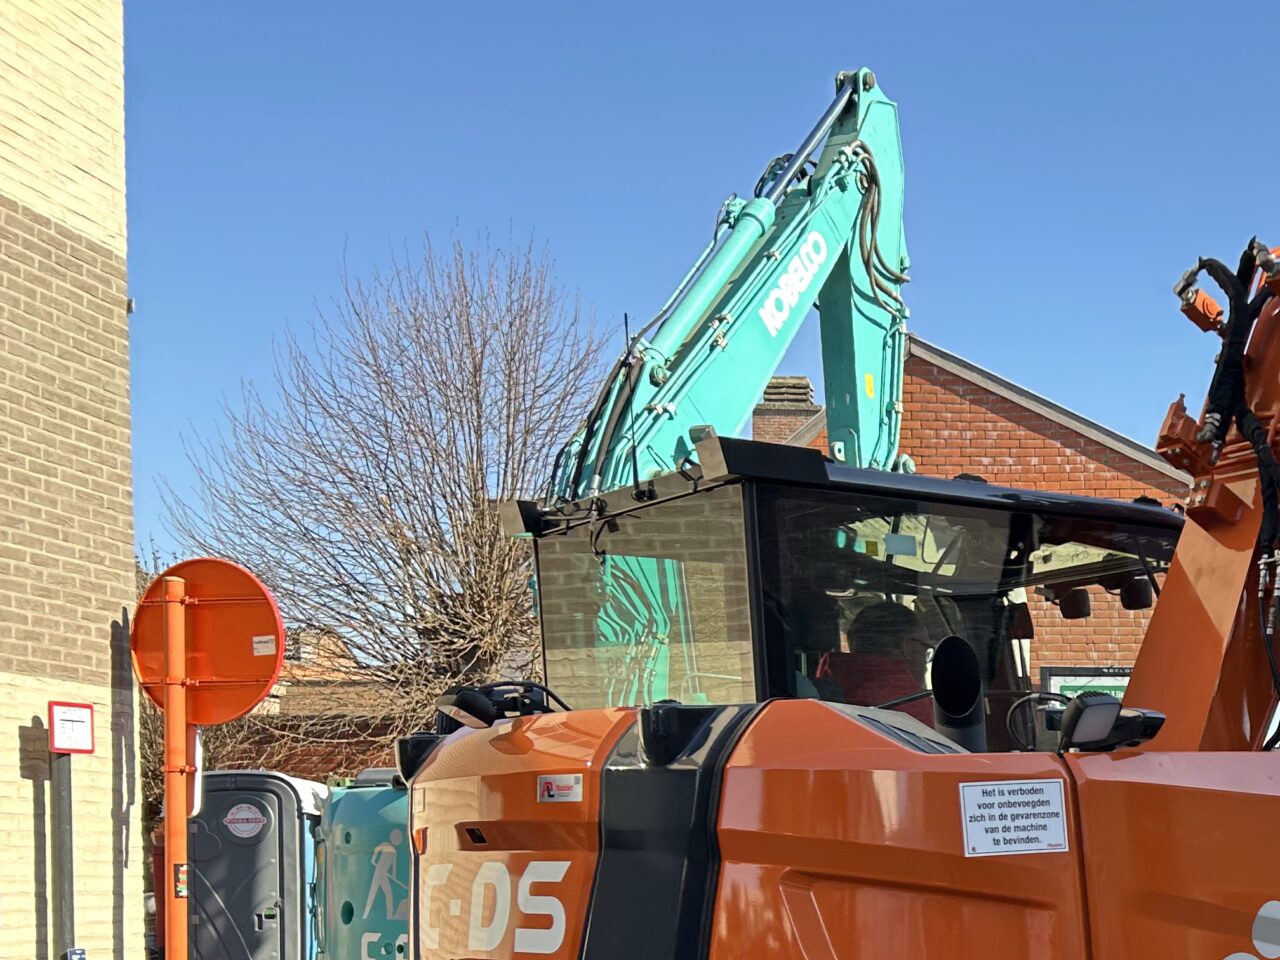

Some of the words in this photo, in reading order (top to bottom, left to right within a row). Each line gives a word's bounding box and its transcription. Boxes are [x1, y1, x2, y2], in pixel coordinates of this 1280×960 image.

[758, 231, 828, 337] KOBELCO
[982, 788, 996, 797] Het
[998, 788, 1005, 796] is
[1007, 786, 1044, 796] verboden
[977, 802, 995, 810] voor
[998, 799, 1051, 809] onbevoegden
[969, 813, 986, 823] zich
[988, 813, 997, 822] in
[998, 812, 1009, 821] de
[1010, 810, 1060, 821] gevarenzone
[984, 826, 1000, 834] van
[1001, 824, 1012, 833] de
[1013, 823, 1048, 833] machine
[992, 837, 1001, 846] te
[1003, 835, 1042, 845] bevinden.
[424, 860, 572, 954] C-DS
